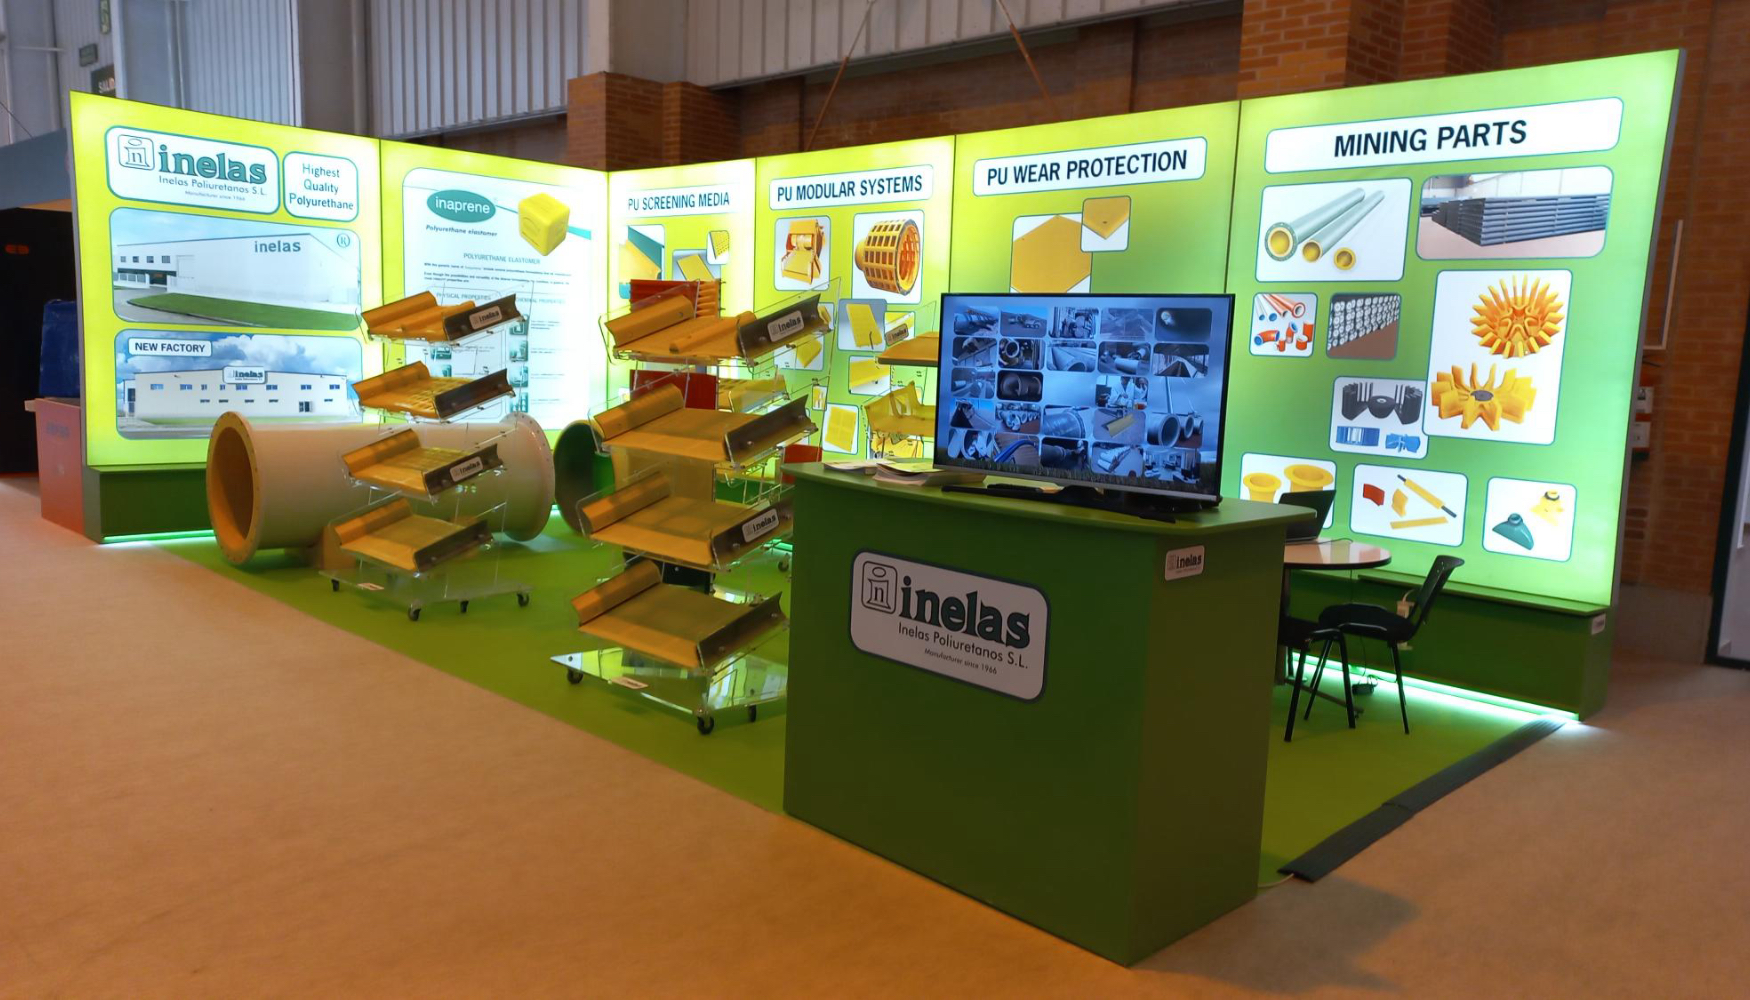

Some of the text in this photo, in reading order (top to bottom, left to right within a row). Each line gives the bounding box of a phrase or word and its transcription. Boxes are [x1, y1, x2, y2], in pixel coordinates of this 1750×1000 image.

[1334, 119, 1527, 158] MINING PARTS
[158, 144, 267, 185] inelas
[302, 163, 340, 178] Highest
[987, 149, 1187, 186] PU WEAR PROTECTION
[159, 175, 267, 196] Inelas Poliuretanos S.L.
[303, 179, 339, 195] Quality
[777, 174, 922, 202] PU MODULAR SYSTEMS
[289, 192, 354, 210] Polyurethane
[435, 196, 490, 214] inaprene
[628, 192, 730, 211] PU SCREENING MEDIA
[425, 224, 498, 237] Polyurethane elastomer
[254, 240, 301, 253] inelas
[463, 252, 541, 264] POLYURETHANE ELASTOMER
[135, 342, 206, 353] NEW FACTORY
[899, 575, 1031, 649] inelas
[898, 622, 1029, 669] Inelas Poliuretanos S.L.
[924, 648, 997, 675] Manufacturer since 1966
